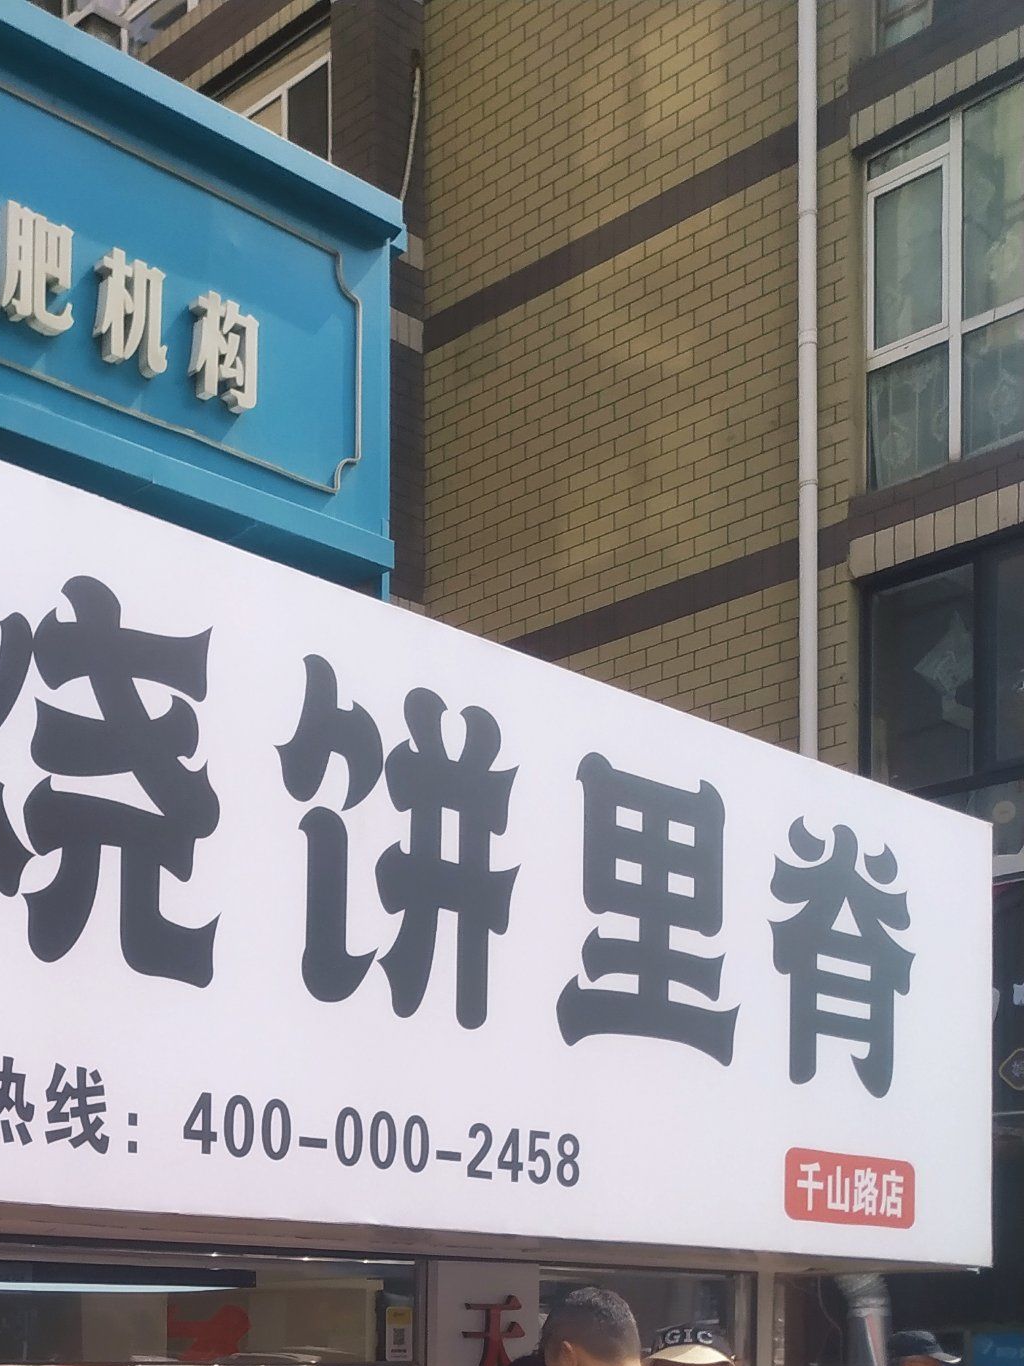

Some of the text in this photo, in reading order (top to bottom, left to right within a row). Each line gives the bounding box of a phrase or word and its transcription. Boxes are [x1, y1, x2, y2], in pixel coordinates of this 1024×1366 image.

[181, 1090, 581, 1187] 400-000-2458
[798, 1162, 905, 1219] 千山路店
